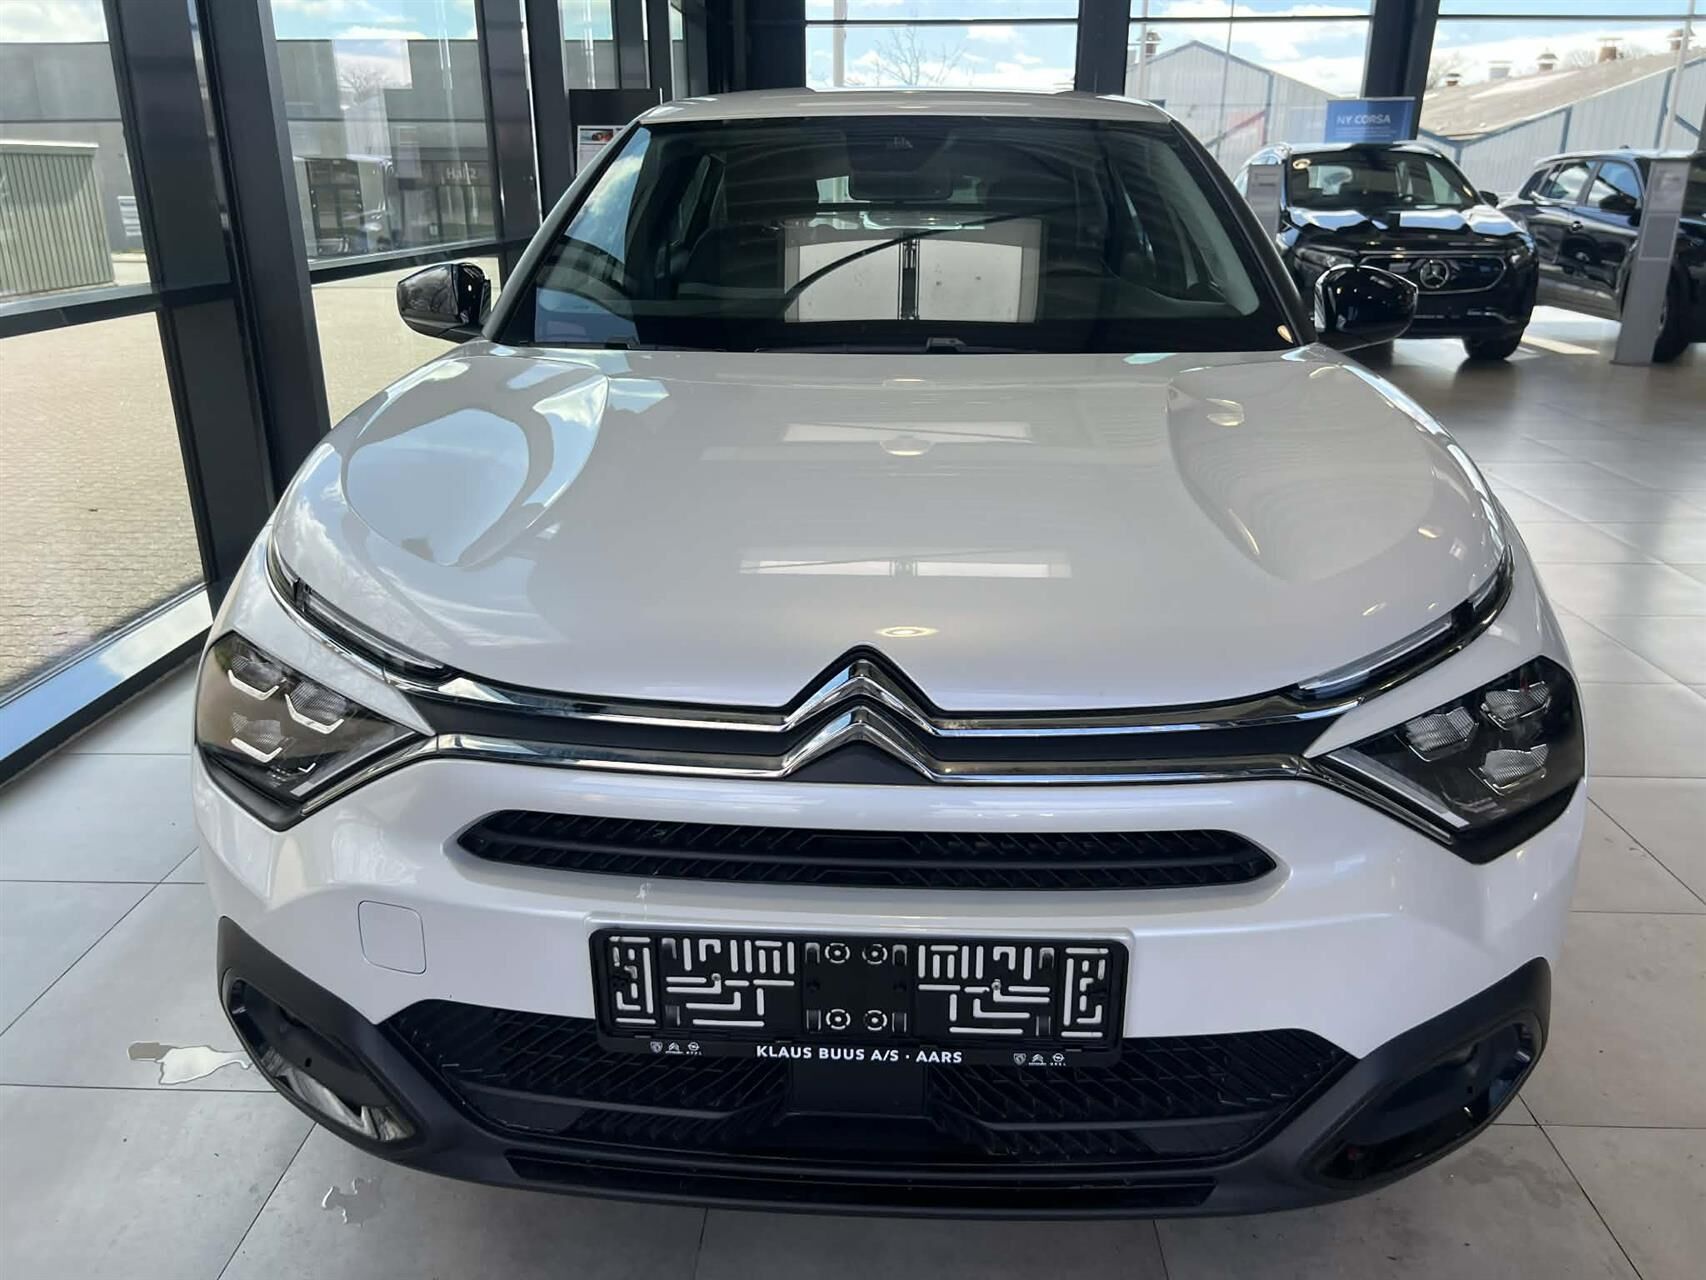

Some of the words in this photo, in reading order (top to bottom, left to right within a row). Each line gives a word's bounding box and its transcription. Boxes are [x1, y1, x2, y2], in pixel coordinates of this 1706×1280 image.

[1336, 115, 1352, 125] NY
[1354, 114, 1391, 124] CORSA
[756, 1045, 812, 1059] KLAUS
[819, 1047, 865, 1060] BUUS
[870, 1049, 899, 1062] A/S
[916, 1050, 963, 1063] AARS
